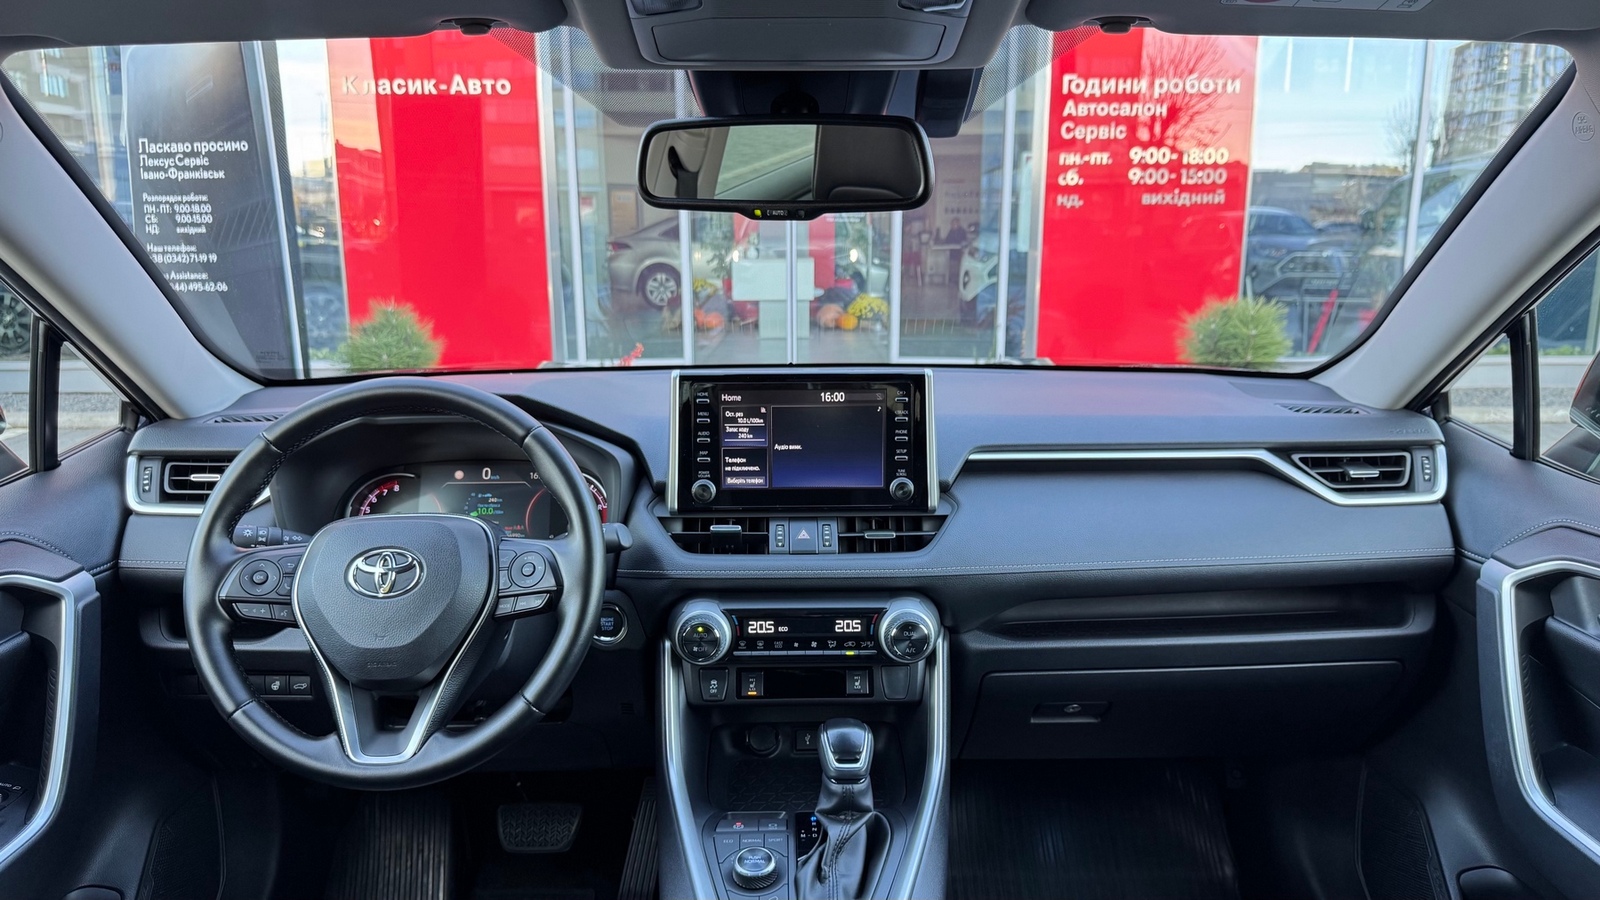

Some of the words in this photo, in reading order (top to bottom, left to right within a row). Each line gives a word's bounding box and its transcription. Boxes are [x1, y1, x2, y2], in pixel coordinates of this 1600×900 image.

[341, 74, 512, 95] Класик-Авто
[1062, 74, 1147, 98] Години
[1154, 74, 1241, 98] роботи
[1063, 98, 1168, 117] Автосалон
[1060, 121, 1128, 143] Сервіс
[193, 140, 249, 155] просимо
[140, 167, 226, 182] Івано-Франківськ
[1057, 167, 1085, 186] сб.
[1056, 193, 1085, 208] нд.
[1141, 188, 1226, 207] вихідний
[176, 224, 207, 235] вихідний
[721, 393, 742, 402] Home
[820, 392, 846, 403] 16:00
[724, 456, 747, 464] Телефон
[482, 467, 492, 480] 0
[393, 484, 400, 492] 8
[371, 496, 378, 504] 6
[365, 506, 371, 514] 5
[477, 507, 494, 515] 10.0
